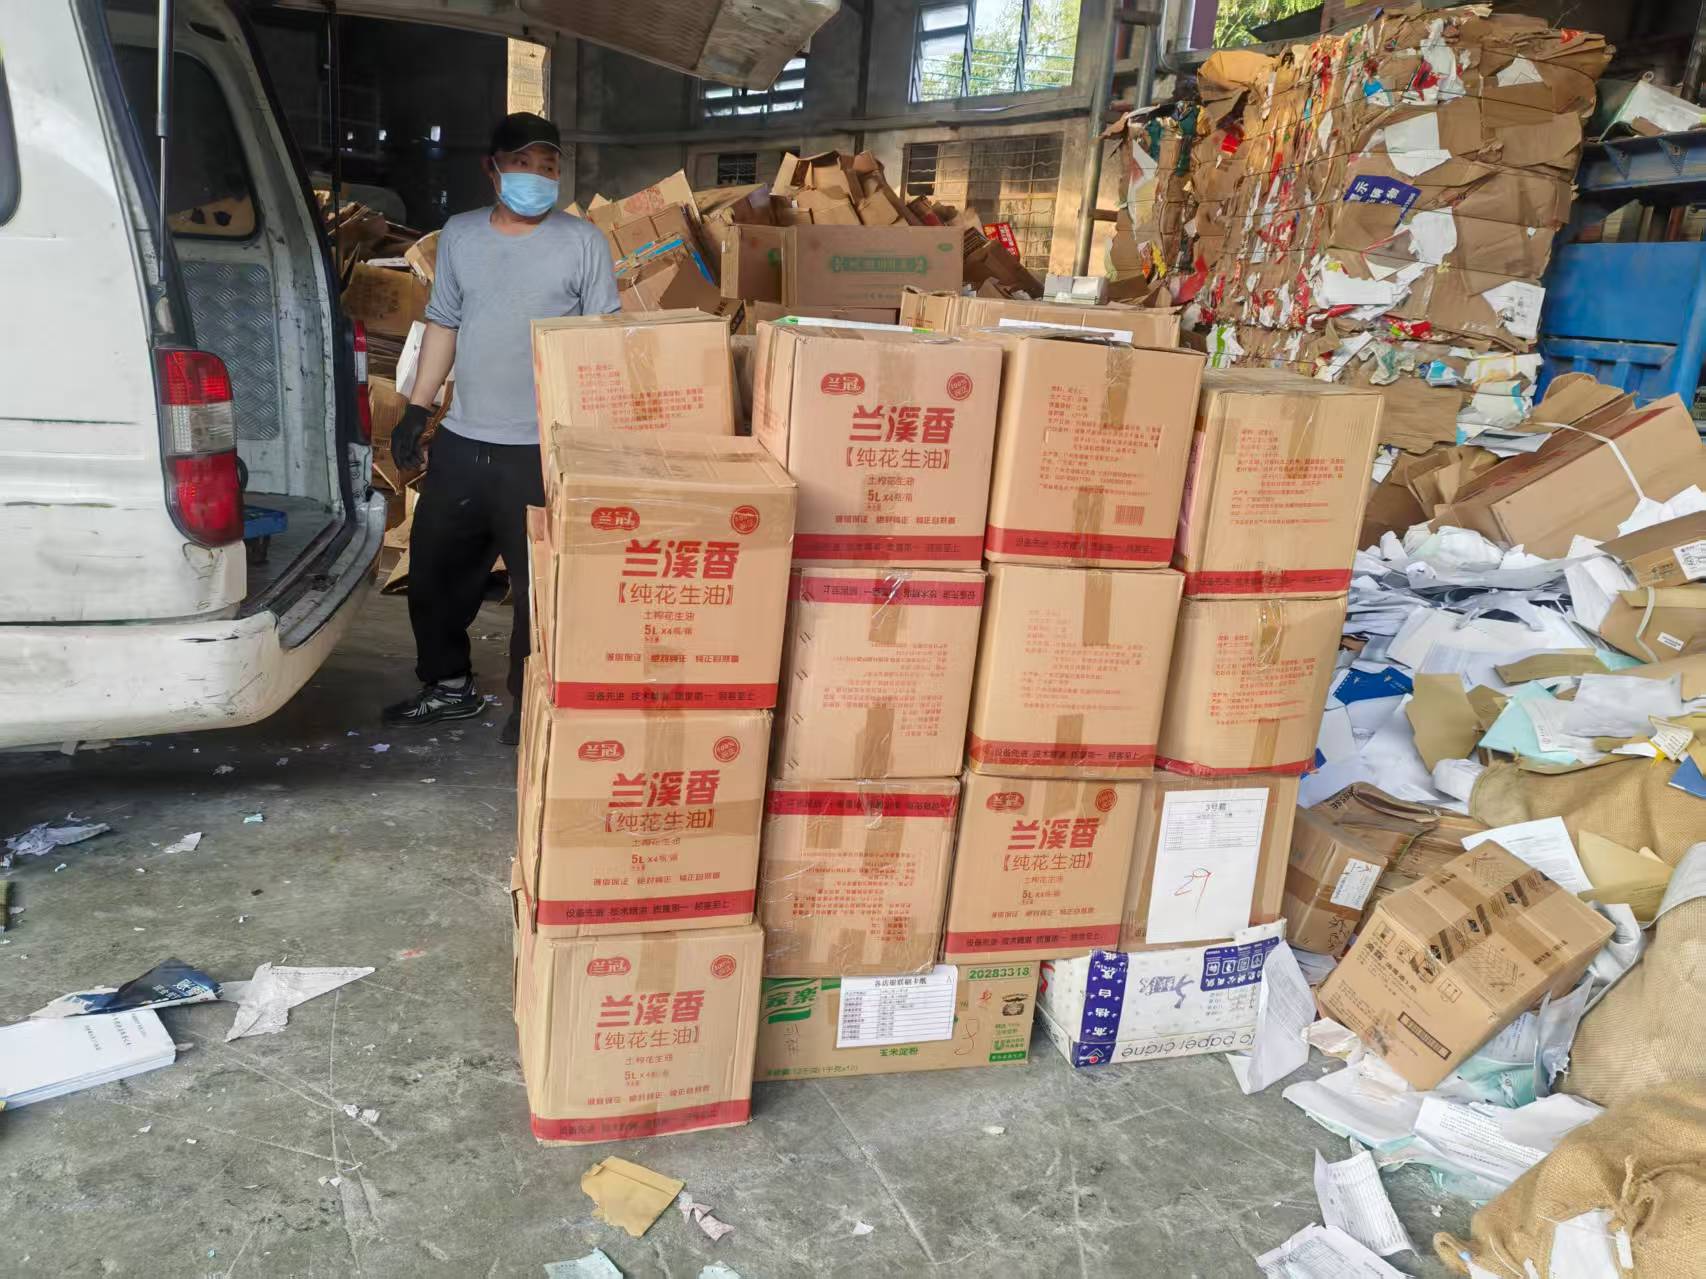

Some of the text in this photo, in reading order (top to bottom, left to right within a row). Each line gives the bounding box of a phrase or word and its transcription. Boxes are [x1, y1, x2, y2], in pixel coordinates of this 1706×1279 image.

[850, 405, 955, 444] 兰溪香
[867, 490, 881, 503] 5L
[622, 539, 741, 580] 兰溪香
[644, 624, 658, 636] 5L
[608, 769, 721, 809] 兰溪香
[1008, 818, 1100, 849] 兰溪香
[631, 855, 645, 865] 5L
[596, 989, 704, 1028] 兰溪香
[879, 1048, 918, 1056] 玉米淀粉
[1179, 1033, 1236, 1052] paper
